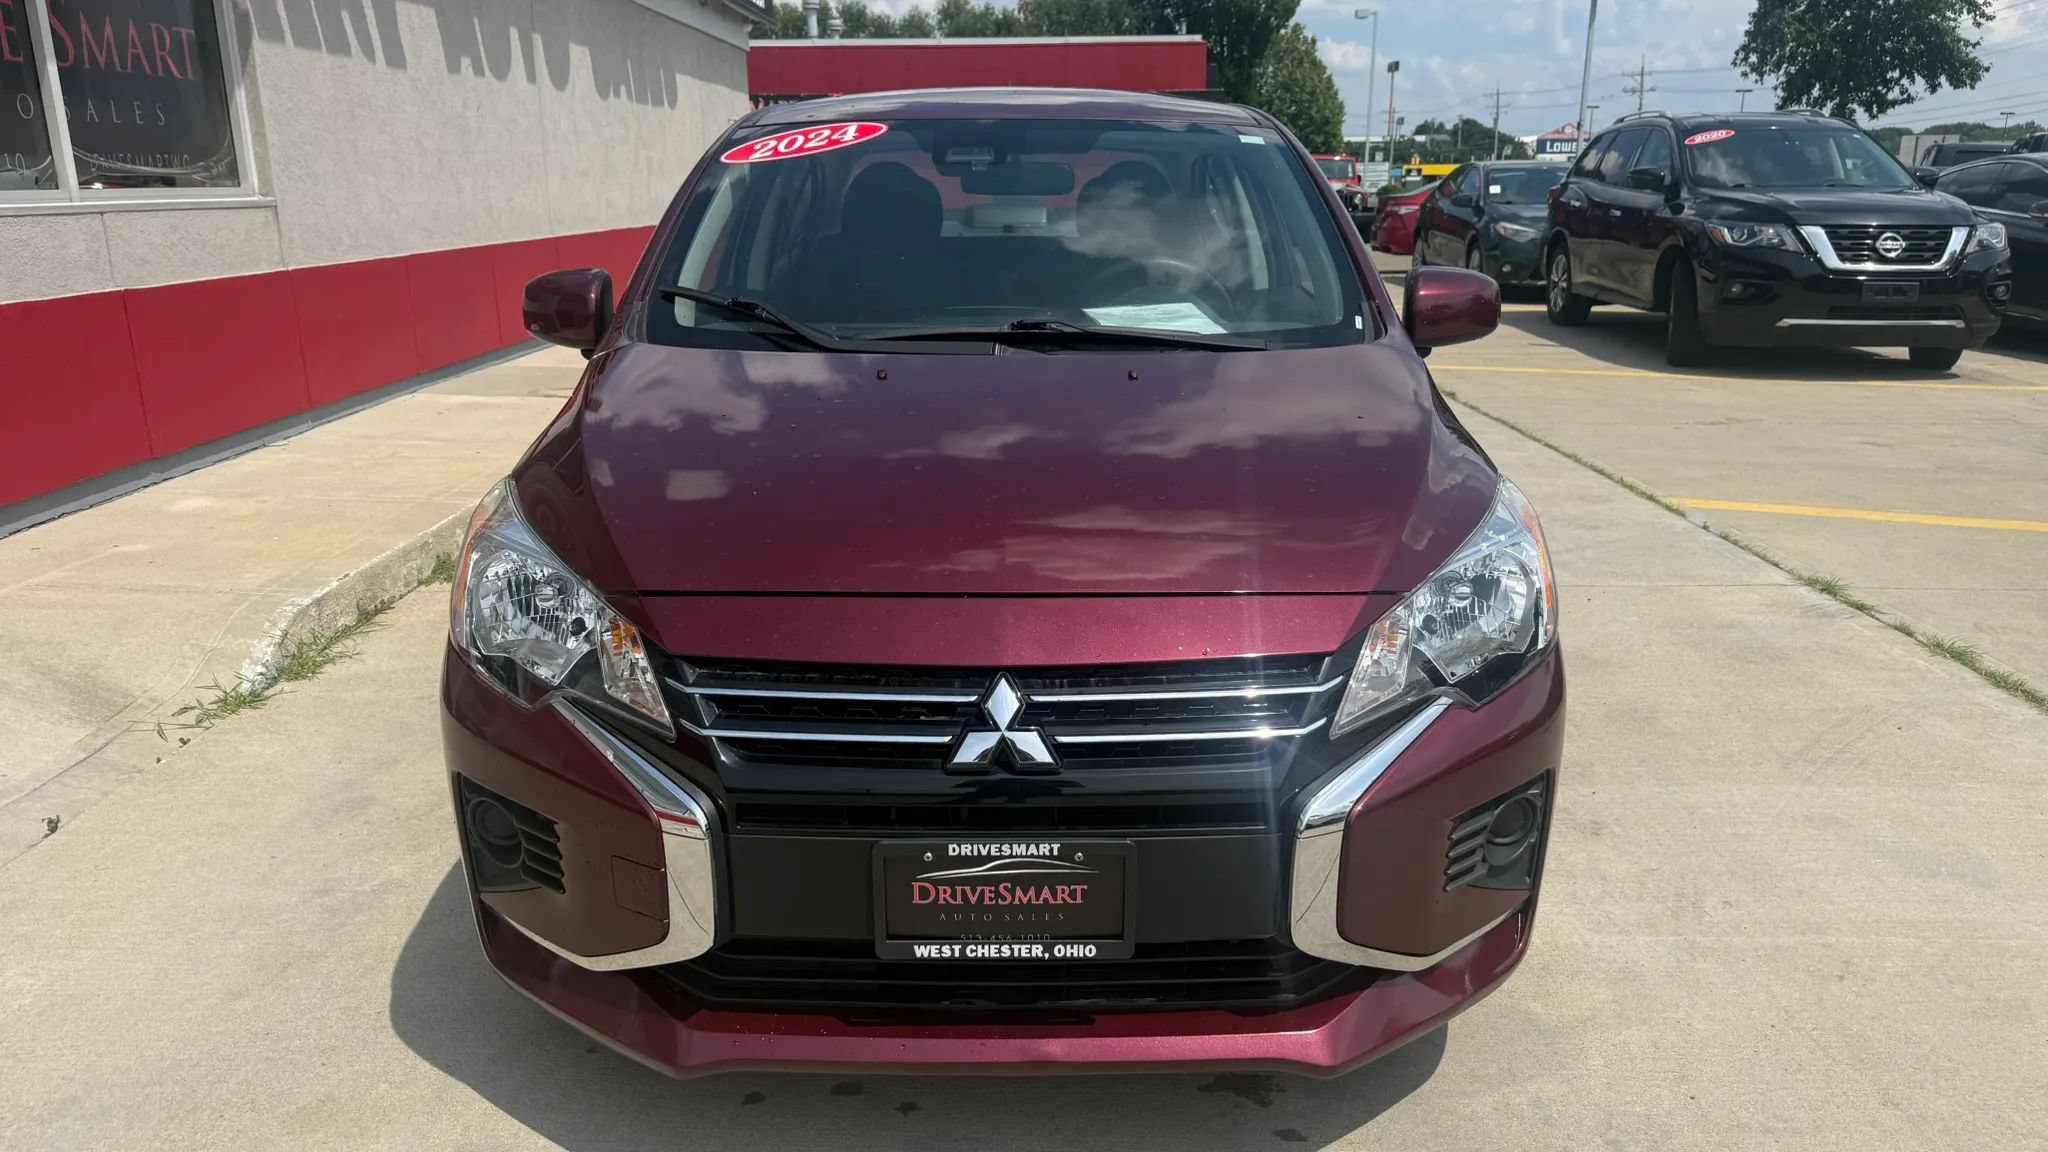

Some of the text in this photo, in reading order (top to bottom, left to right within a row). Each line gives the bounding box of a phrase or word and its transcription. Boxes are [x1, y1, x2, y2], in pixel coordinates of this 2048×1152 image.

[749, 124, 859, 160] 2024
[1694, 131, 1726, 142] 2020
[948, 843, 1061, 856] DRIVESMART
[939, 912, 1064, 921] AUTO SALES
[913, 944, 1097, 960] WEST CHESTER, OHIO
